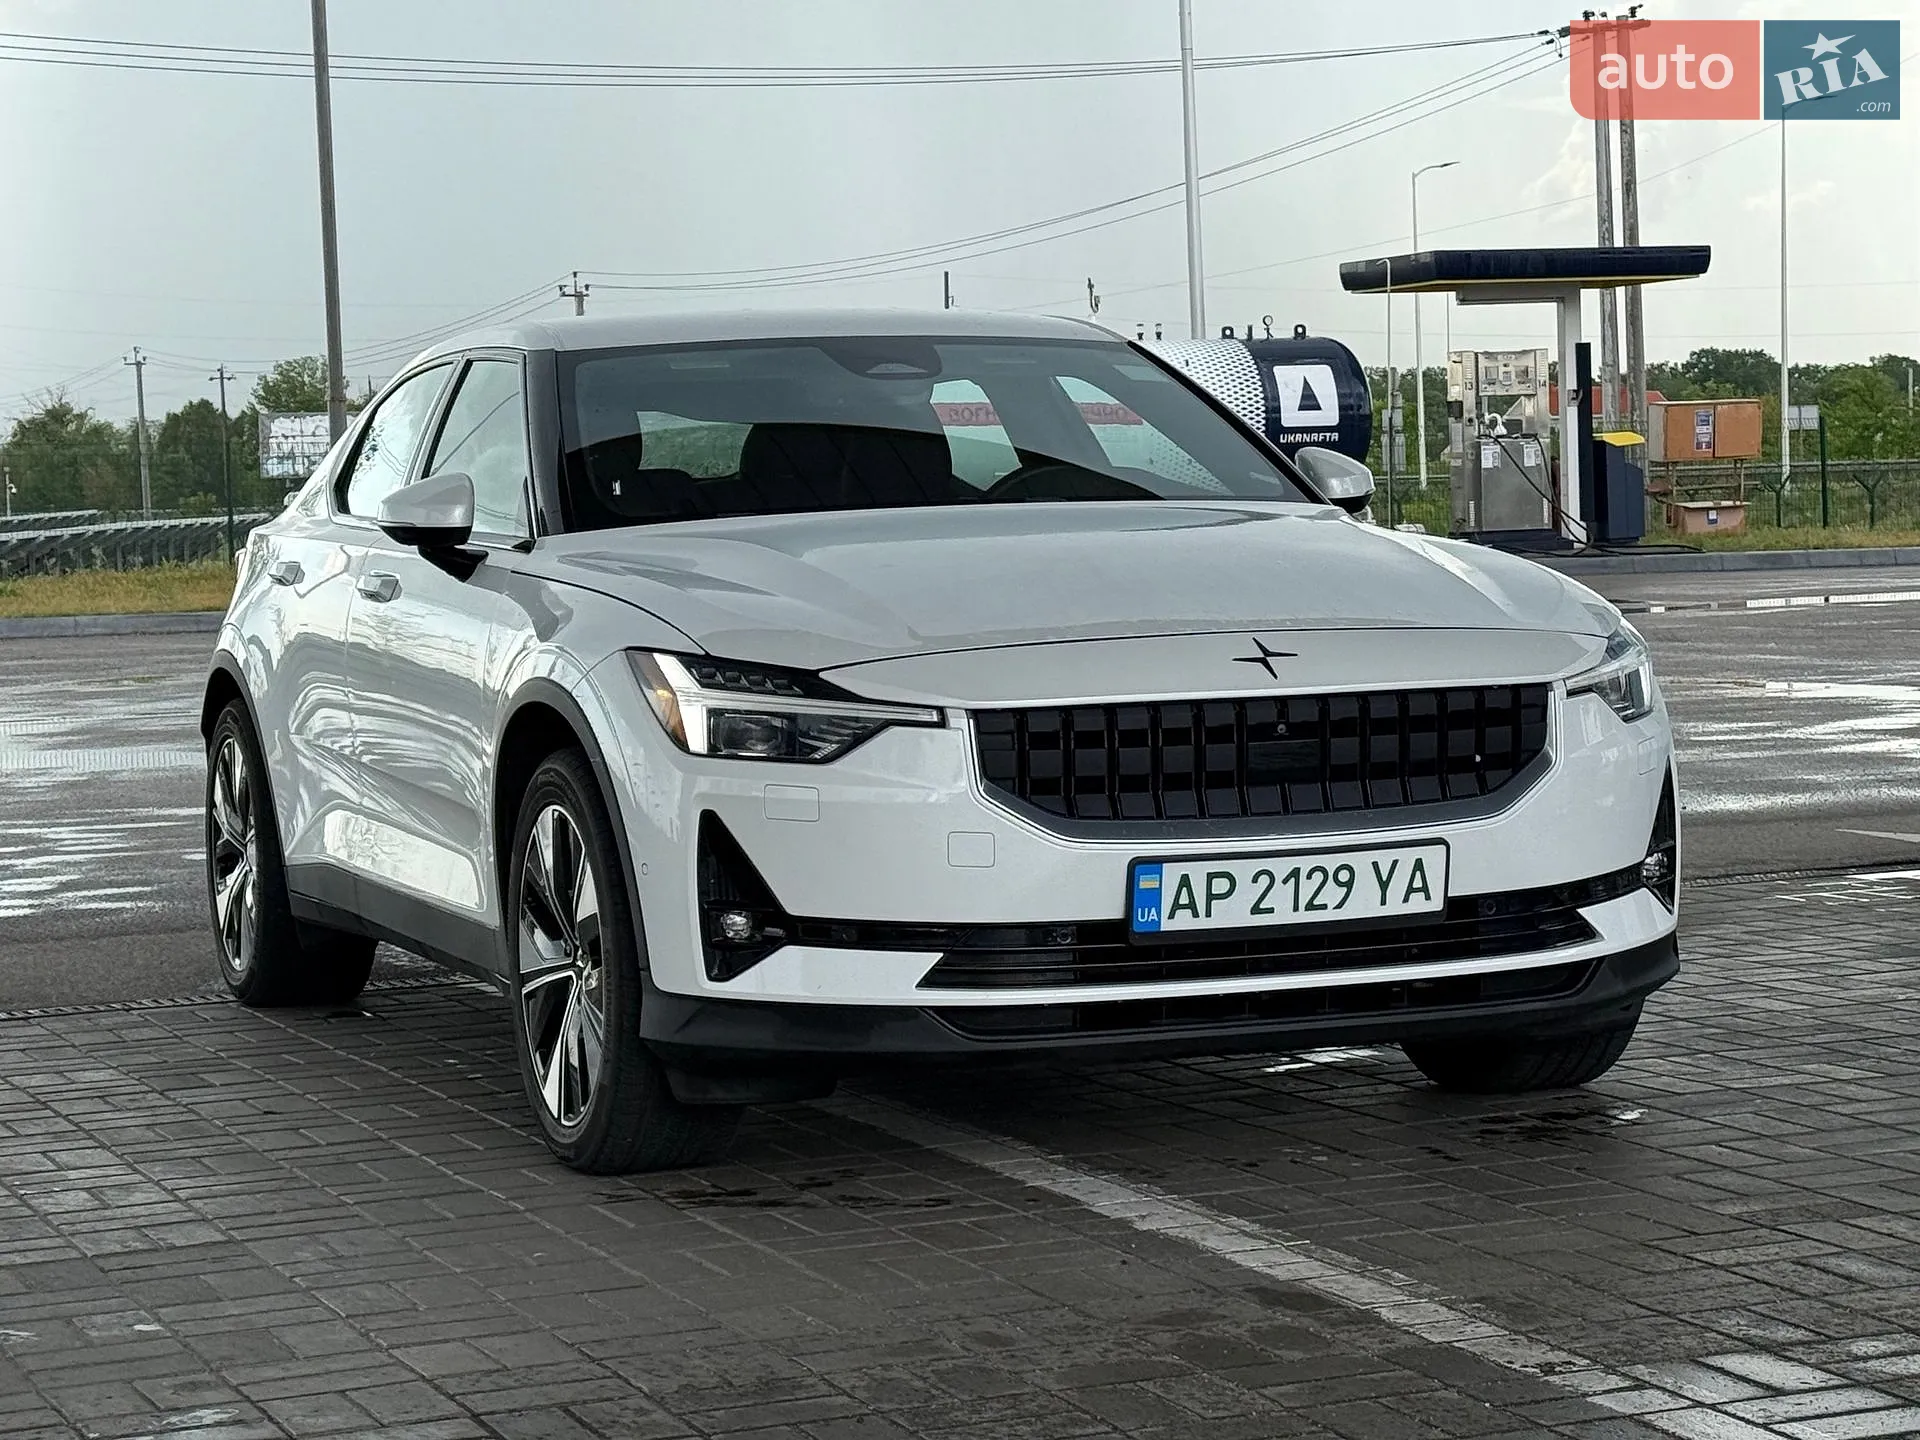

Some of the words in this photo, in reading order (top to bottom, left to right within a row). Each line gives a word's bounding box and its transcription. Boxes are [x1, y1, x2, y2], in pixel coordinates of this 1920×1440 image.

[1464, 381, 1474, 391] 13
[1167, 871, 1237, 920] AP
[1249, 863, 1356, 916] 2129
[1371, 857, 1432, 905] YA
[1137, 905, 1159, 923] UA
